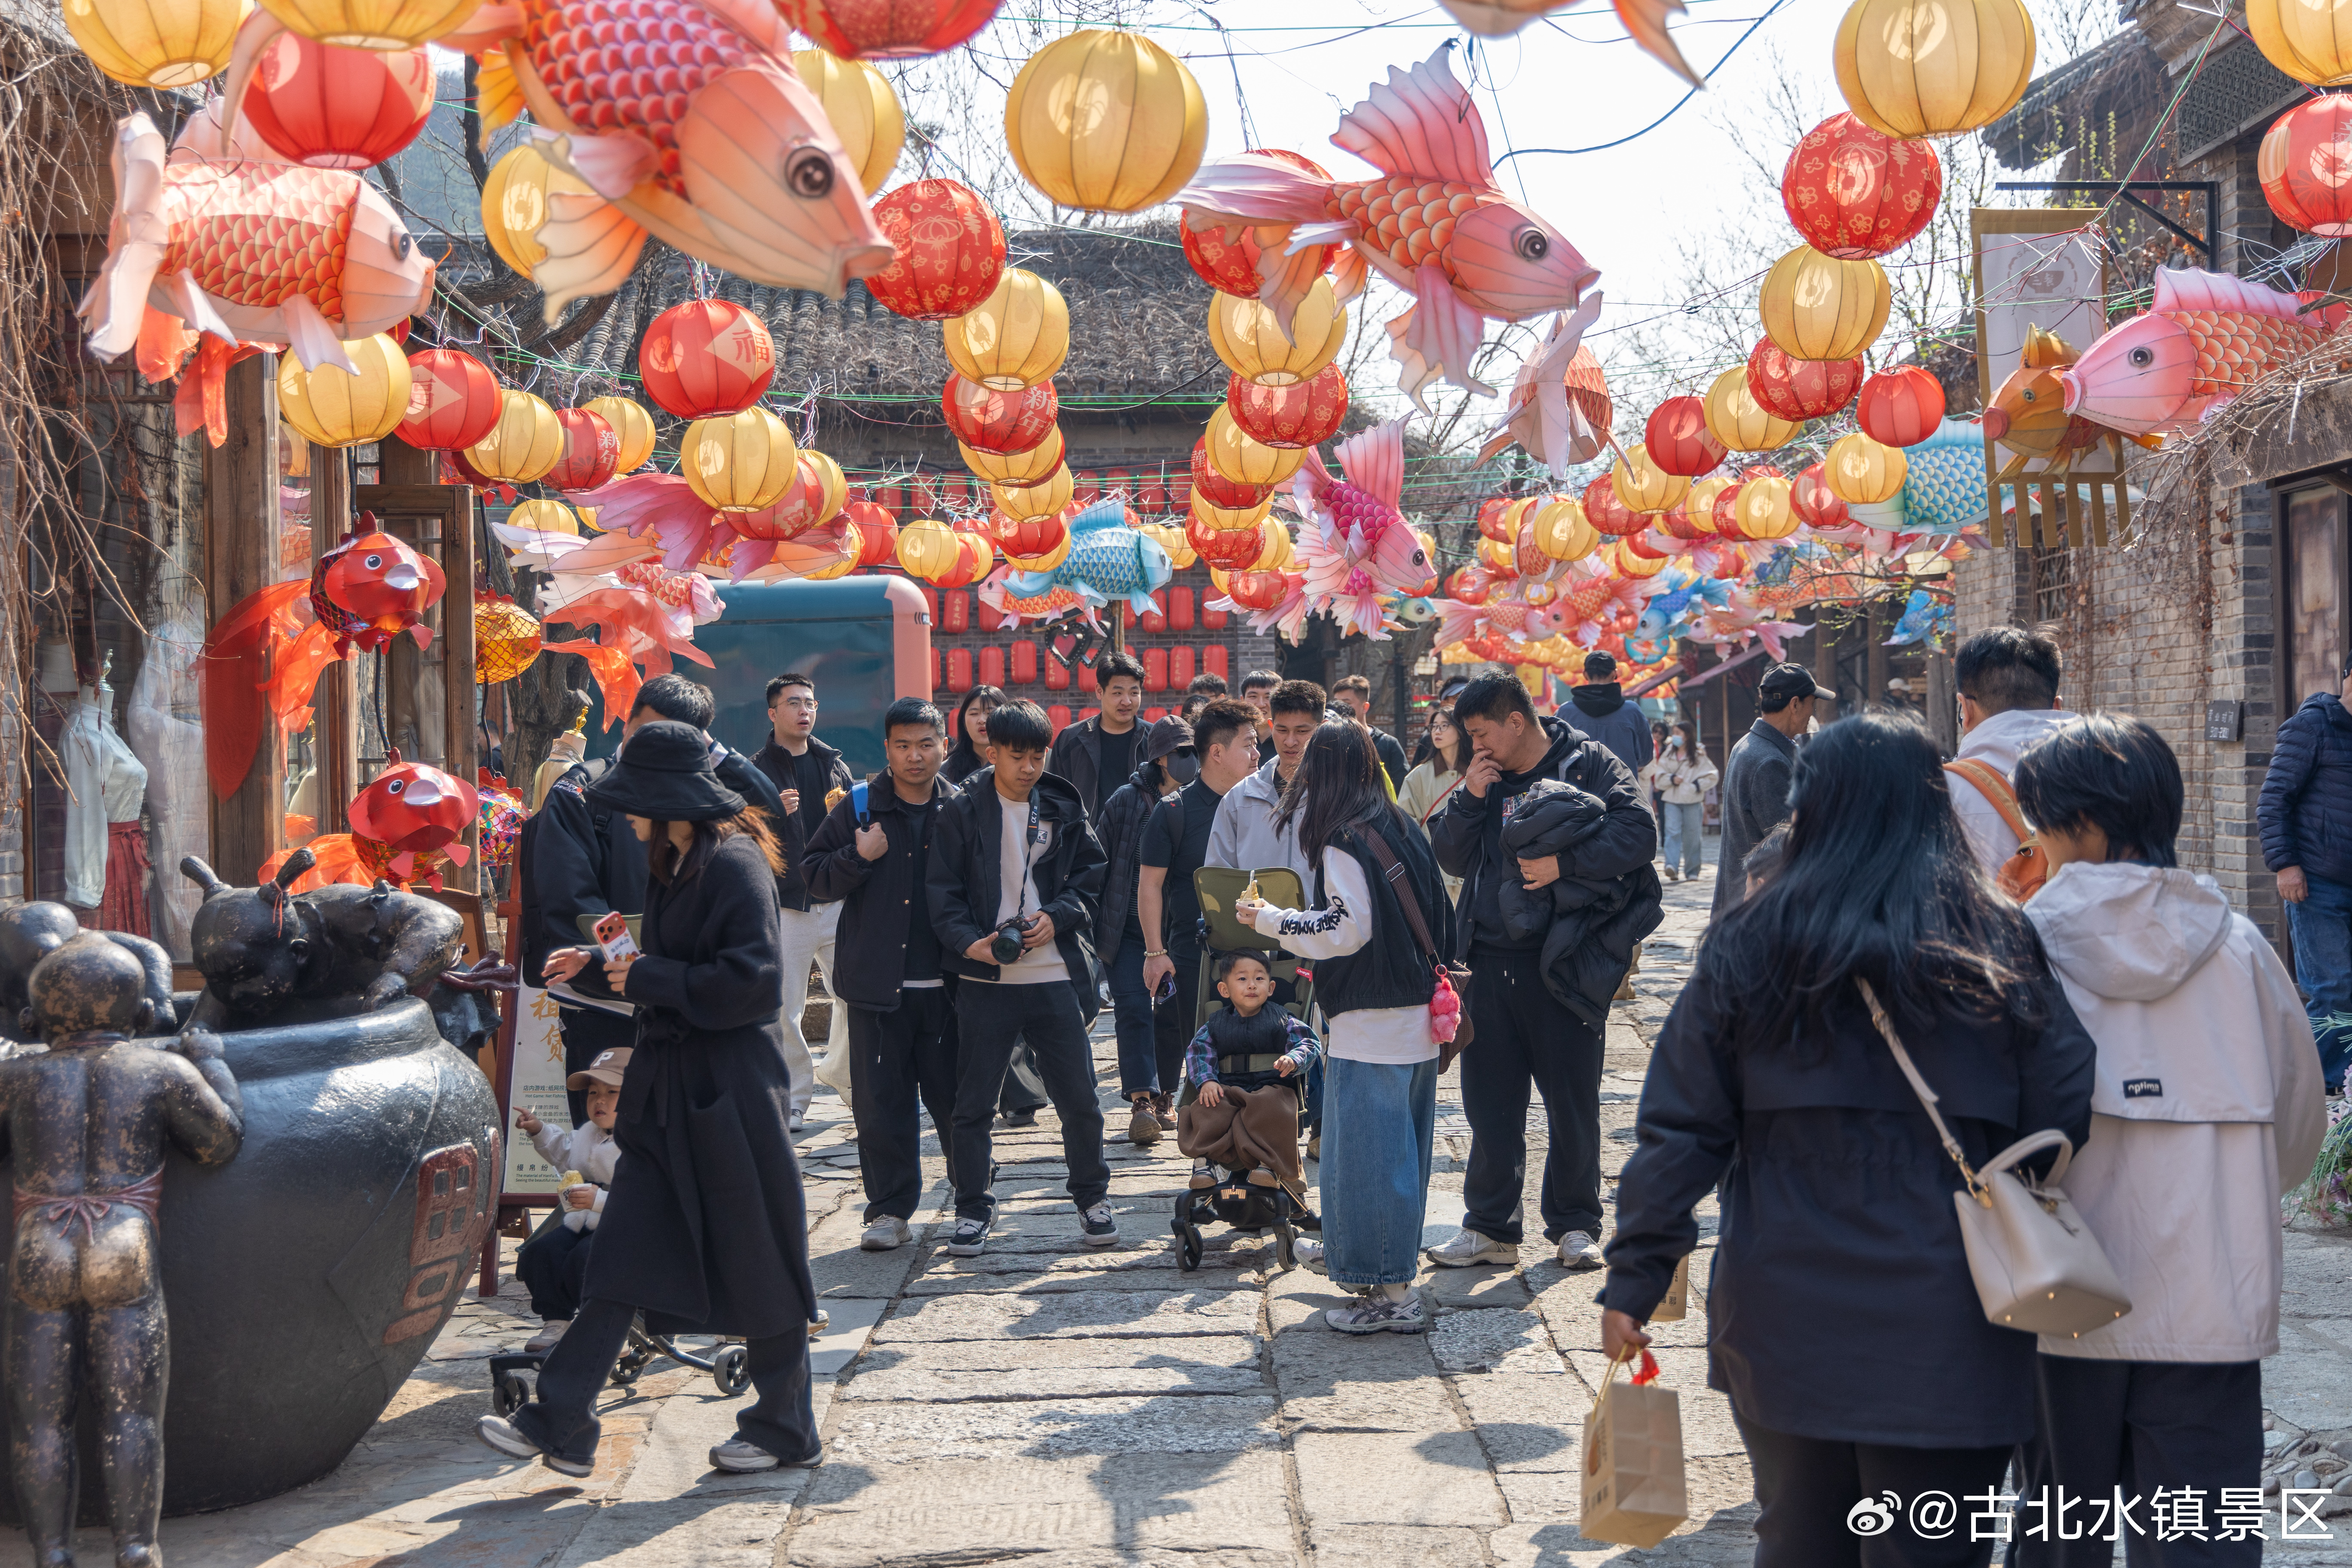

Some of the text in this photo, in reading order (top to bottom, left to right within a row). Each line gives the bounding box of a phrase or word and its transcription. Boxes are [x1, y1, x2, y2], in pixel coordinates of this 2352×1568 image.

[732, 329, 770, 364] 福
[1278, 919, 1316, 936] MOMENT
[1316, 914, 1336, 933] THE
[593, 1051, 615, 1066] P
